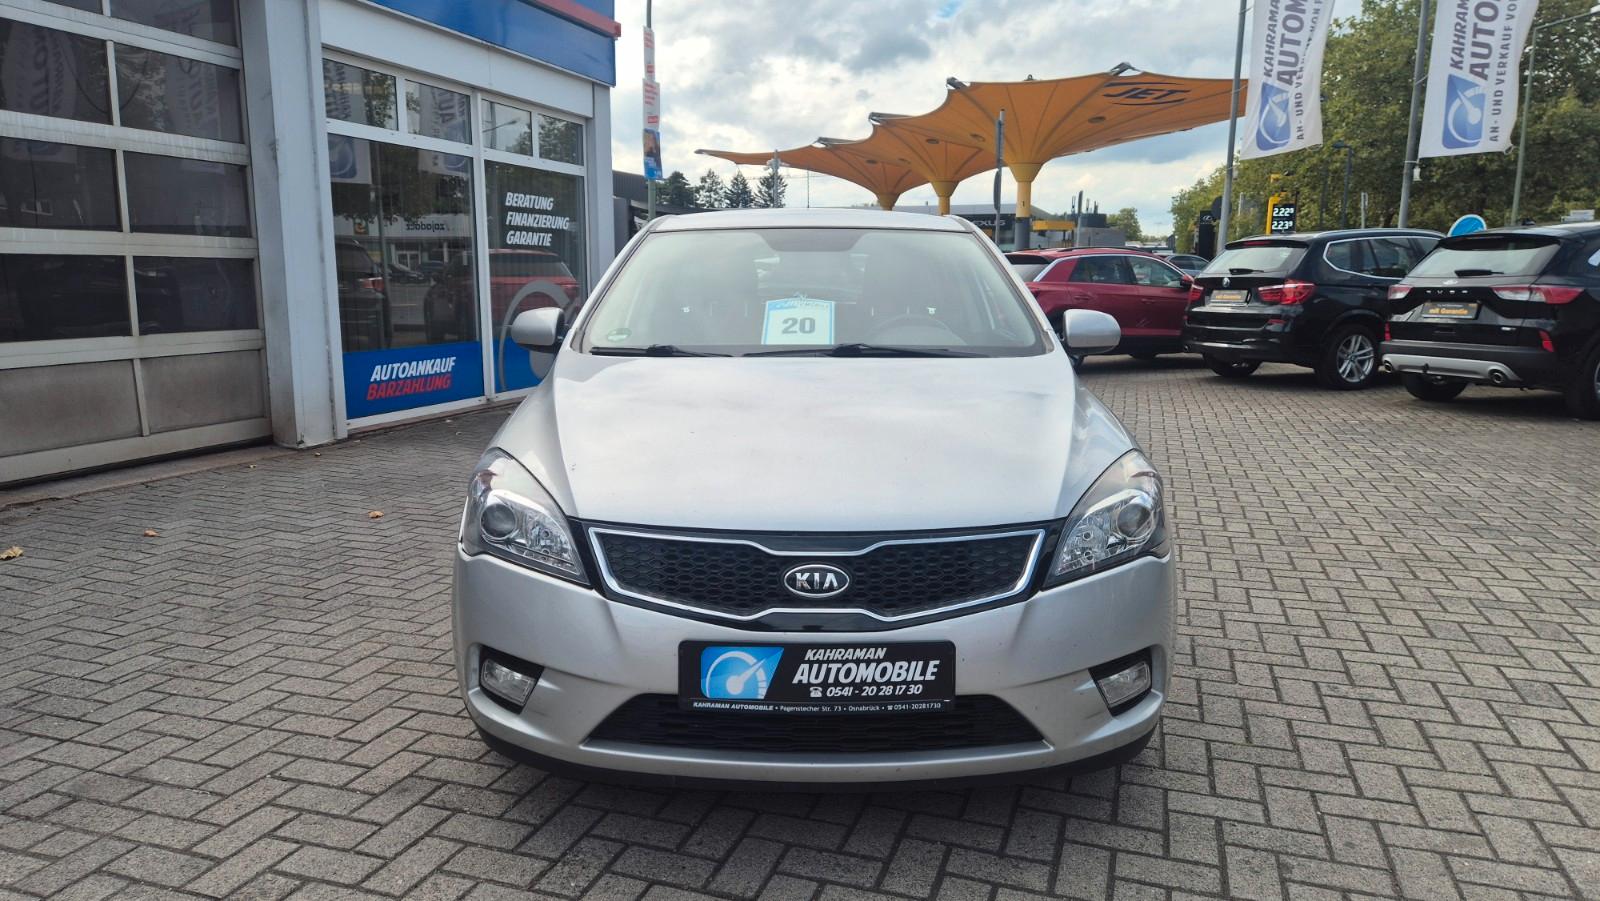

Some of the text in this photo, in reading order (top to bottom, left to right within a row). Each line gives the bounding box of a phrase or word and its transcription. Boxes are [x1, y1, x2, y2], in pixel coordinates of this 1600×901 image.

[1505, 0, 1518, 20] VO
[1469, 0, 1500, 80] AUTO
[1495, 26, 1512, 86] VERKAUF
[1102, 87, 1191, 101] JET
[1492, 90, 1503, 115] UND
[1295, 92, 1305, 116] UND
[505, 192, 554, 211] BERATUNG
[506, 211, 570, 230] FINANZIERUNG
[506, 230, 552, 247] GARANTIE
[782, 317, 816, 334] 20
[370, 356, 456, 382] AUTOANKAUF
[367, 373, 451, 400] BARZAHLUNG
[795, 572, 839, 590] KIA
[804, 648, 887, 661] KAHRAMAN
[792, 660, 940, 684] AUTOMOBILE
[826, 686, 852, 697] 0541
[861, 686, 877, 696] 20
[878, 686, 894, 696] 28
[895, 685, 906, 695] 17
[906, 684, 923, 695] 30
[693, 701, 730, 709] KAHRAMAN
[731, 703, 774, 711] AUTOMOBILE
